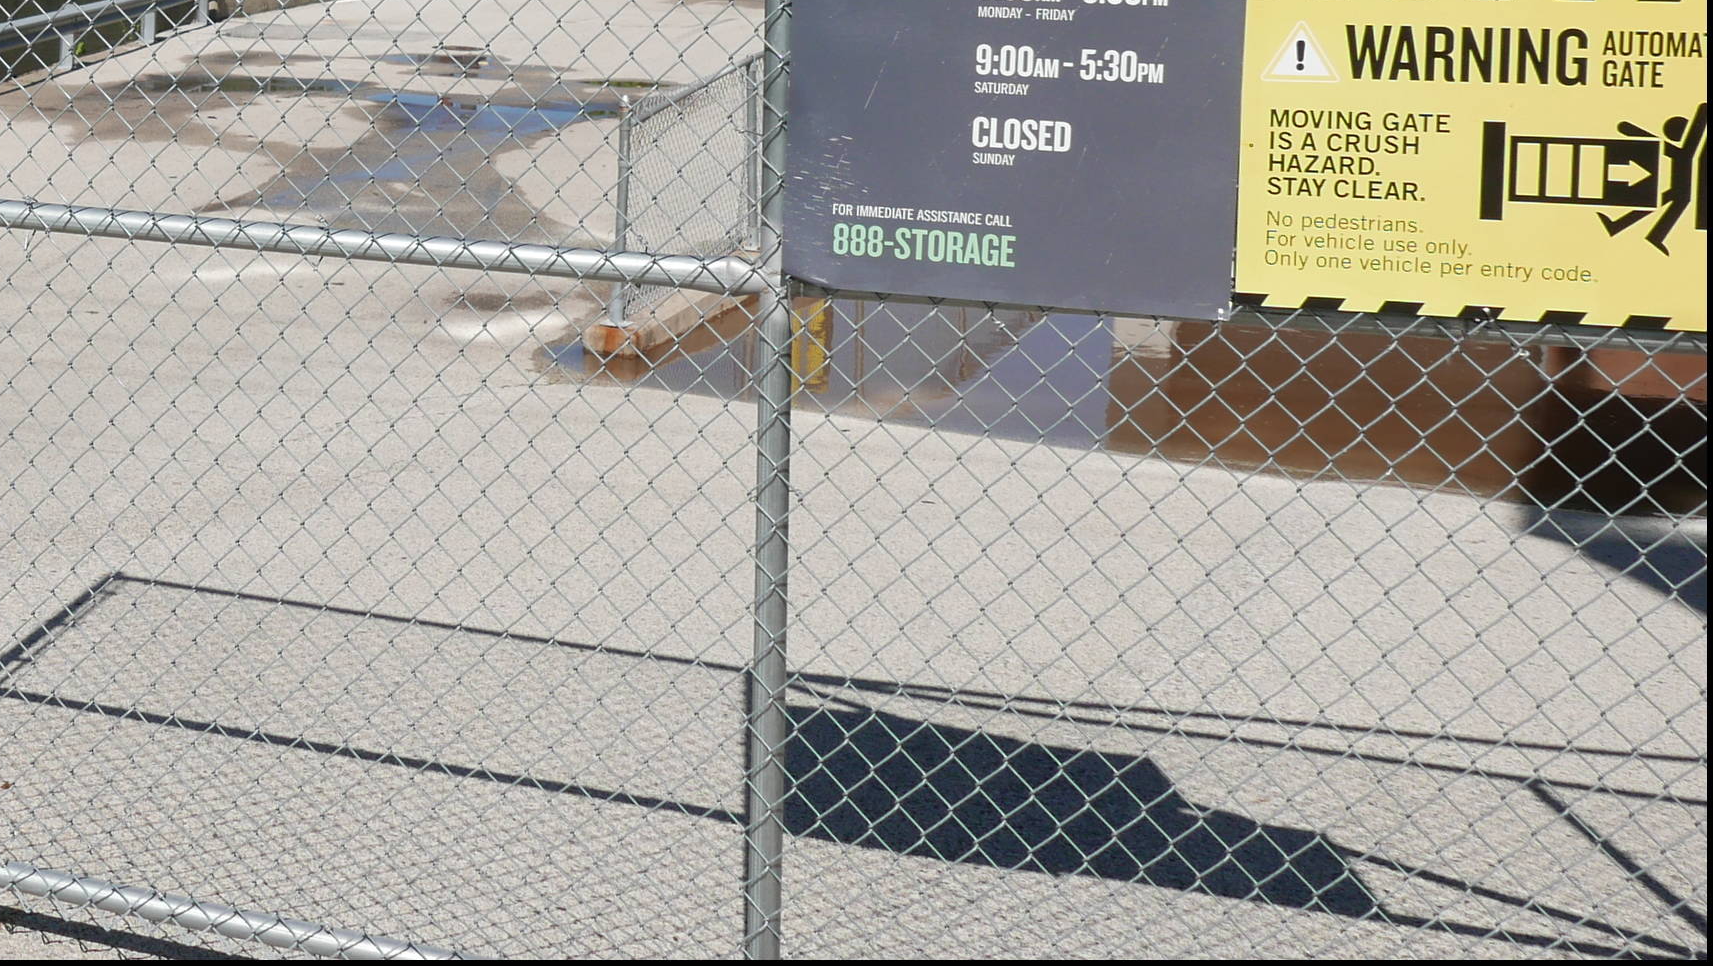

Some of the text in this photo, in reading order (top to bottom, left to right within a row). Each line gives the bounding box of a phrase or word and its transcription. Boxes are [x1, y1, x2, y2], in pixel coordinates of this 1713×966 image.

[978, 6, 1023, 18] MONDAY
[1036, 8, 1075, 21] FRIDAY
[1346, 25, 1588, 86] WARNING
[1603, 31, 1707, 58] AUTOMA
[976, 44, 1059, 78] 9:00AM
[1080, 49, 1164, 83] 5:30PM
[1603, 60, 1664, 88] GATE
[974, 82, 1029, 95] SATURDAY
[1270, 109, 1450, 133] MOVING GATE
[972, 116, 1071, 152] CLOSED
[1270, 131, 1419, 154] IS A CRUSH
[973, 153, 1015, 165] SUNDAY
[1269, 154, 1380, 177] HAZARD.
[1267, 177, 1425, 201] STAY CLEAR.
[833, 203, 1012, 227] FOR IMMEDIATE ASSISTANCE CALL
[1267, 210, 1423, 235] No pedestrians.
[833, 223, 1016, 267] 888-STORAGE
[1266, 230, 1472, 258] For vehicle use only.
[1265, 250, 1598, 282] Only one vehicle per entry code.
